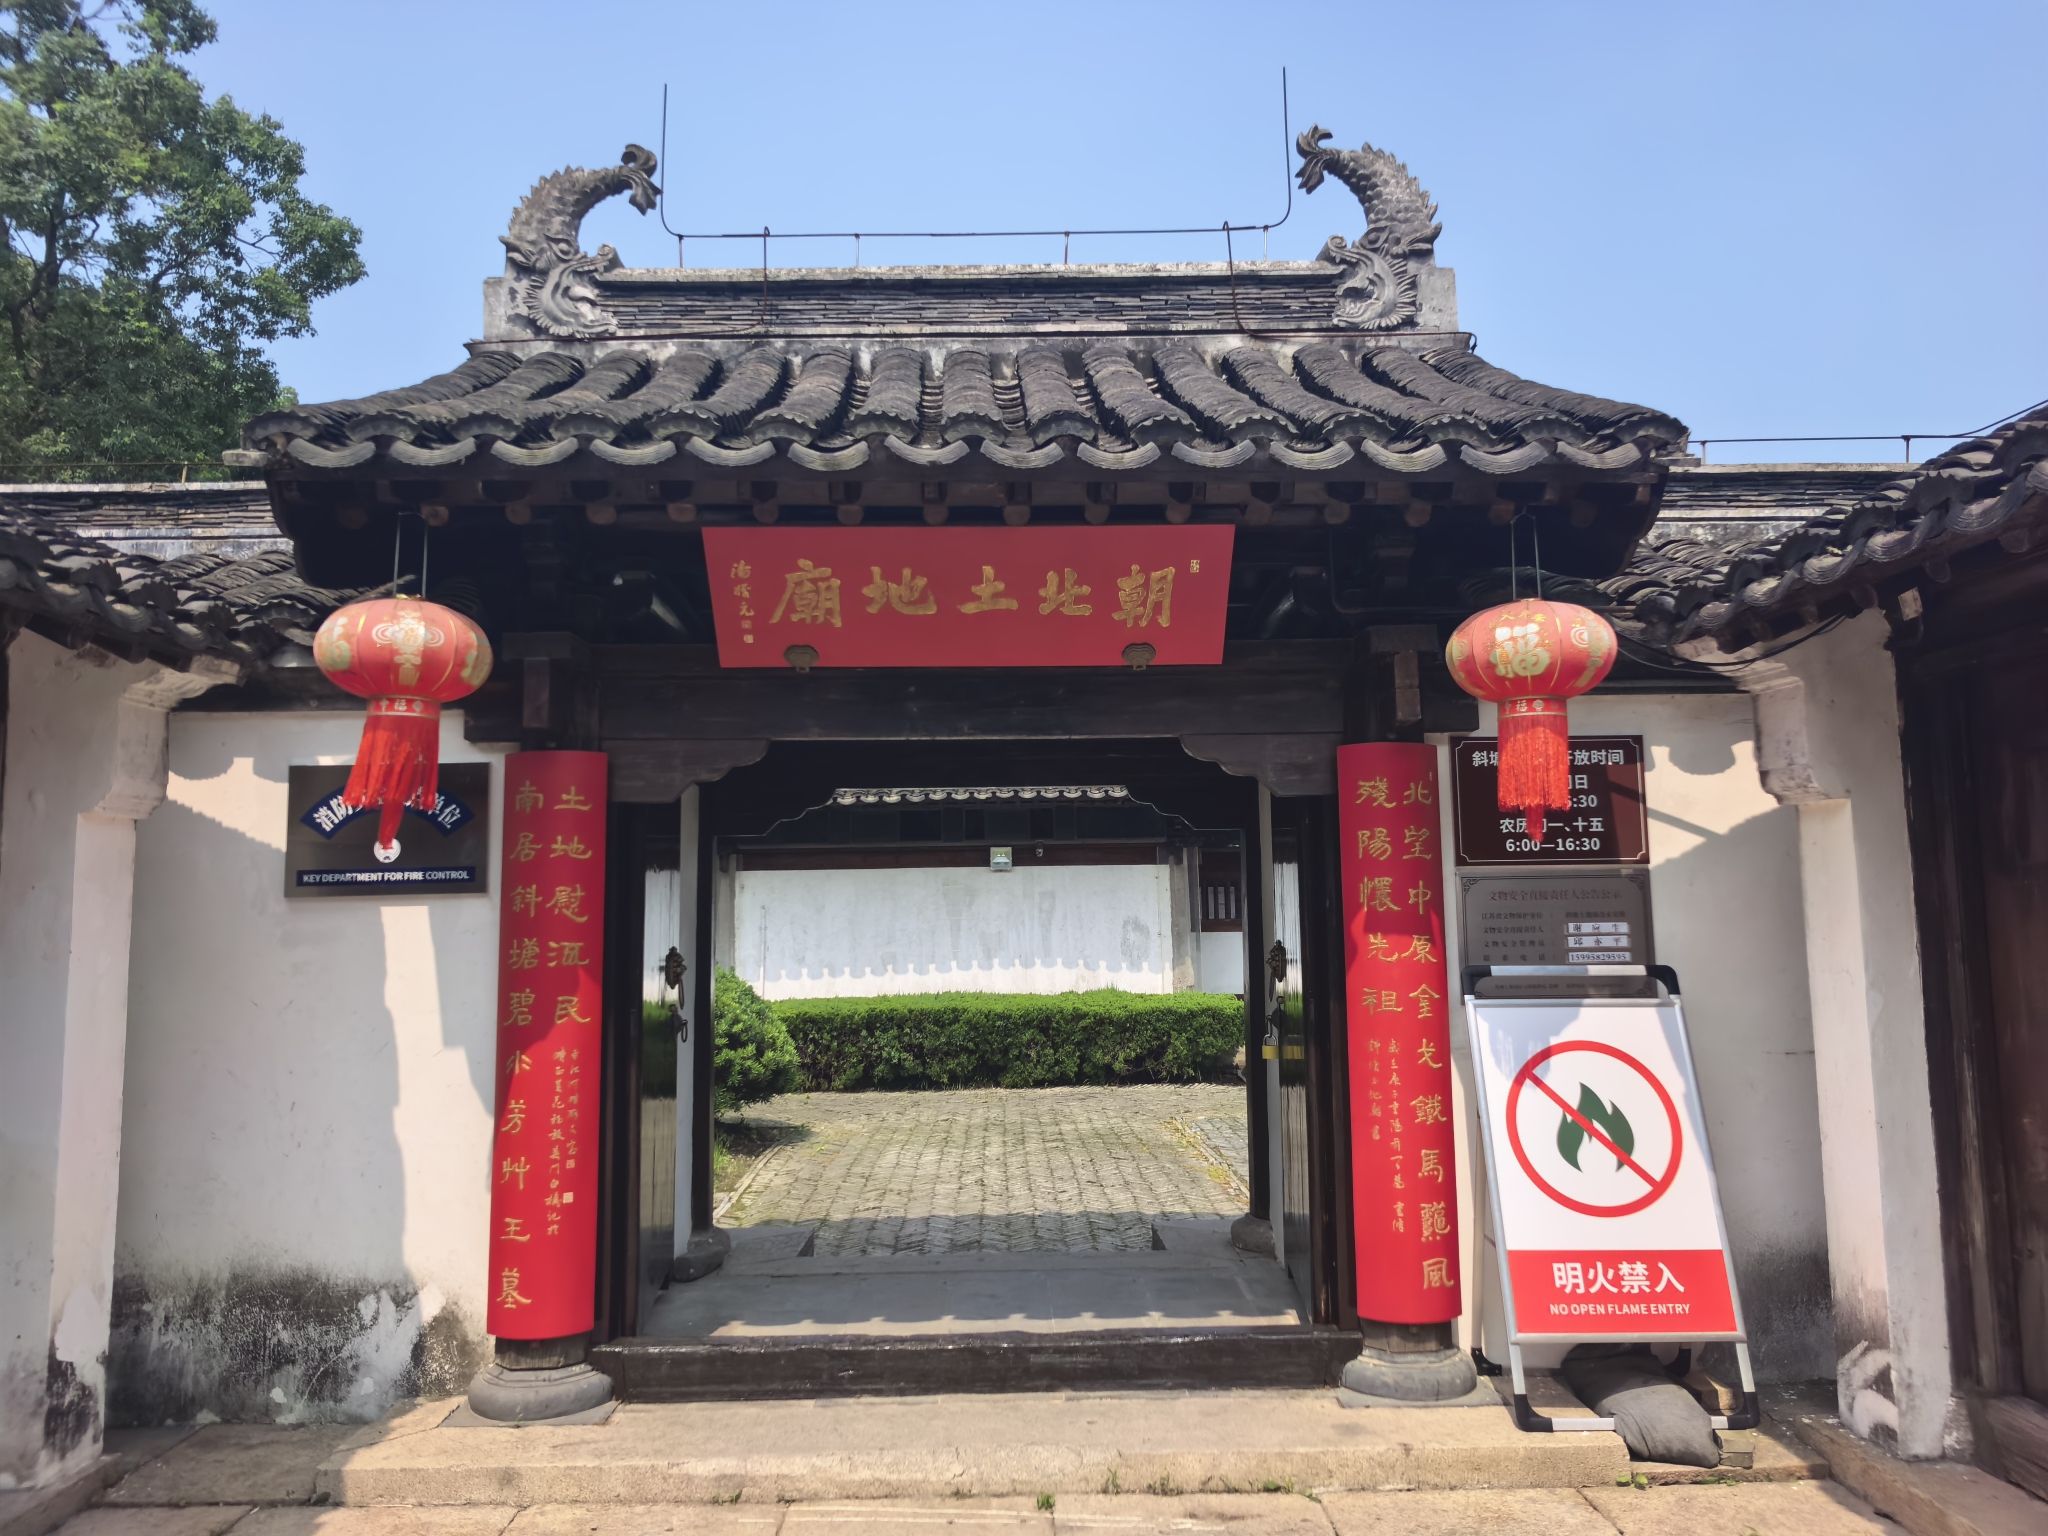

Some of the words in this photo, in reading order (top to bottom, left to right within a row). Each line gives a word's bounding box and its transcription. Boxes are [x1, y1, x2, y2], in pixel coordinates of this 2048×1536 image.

[303, 874, 321, 882] KEY
[322, 873, 384, 882] DEPARTMENT
[384, 872, 403, 881] FOR
[404, 871, 424, 880] FIRE
[425, 871, 469, 880] CONTROL
[1551, 1261, 1685, 1294] 明火禁入
[1550, 1304, 1568, 1315] NO
[1571, 1304, 1605, 1315] OPEN
[1608, 1304, 1648, 1315] FLAME
[1650, 1303, 1691, 1315] ENTRY
